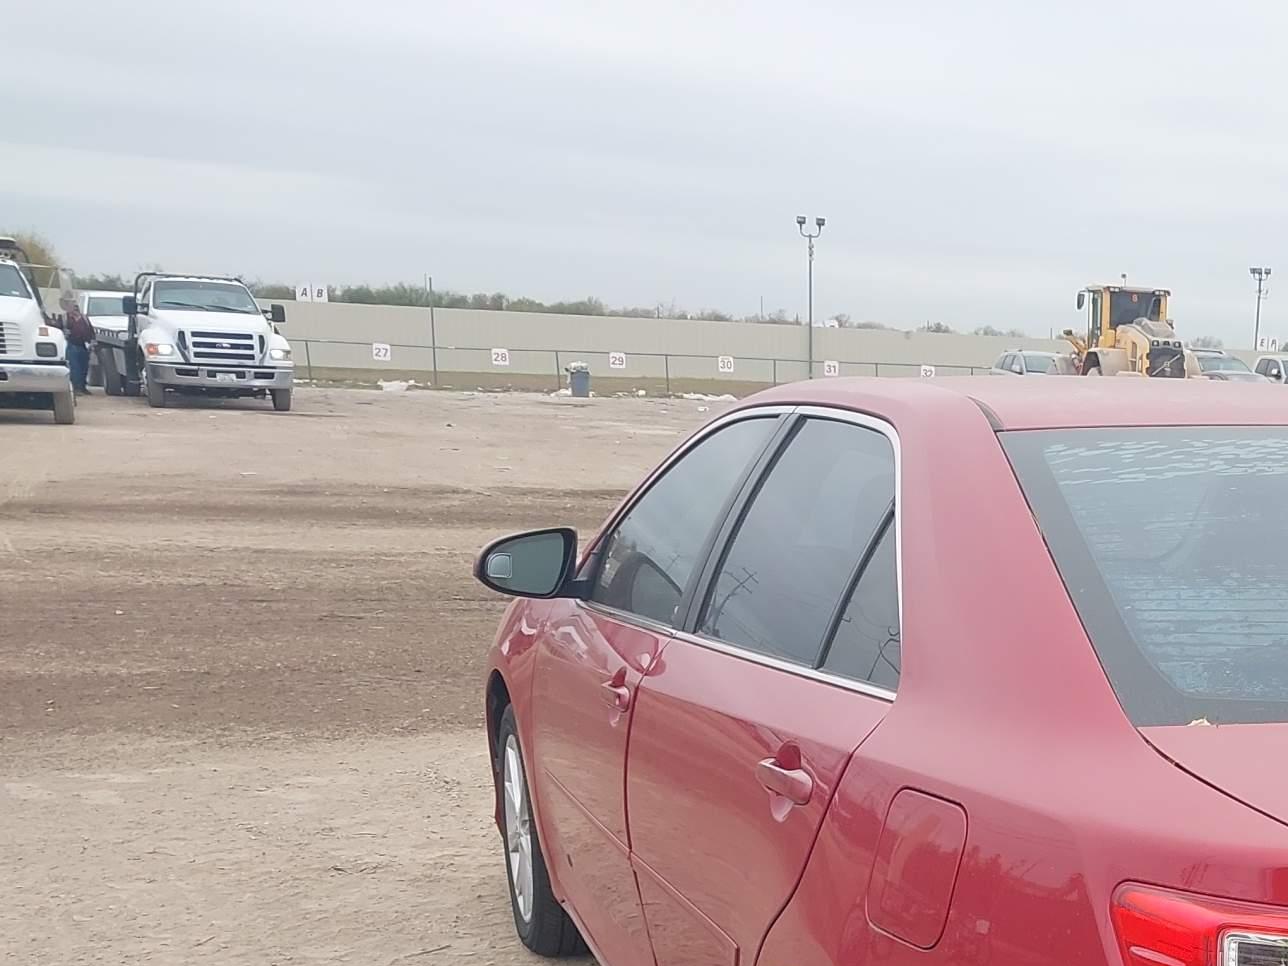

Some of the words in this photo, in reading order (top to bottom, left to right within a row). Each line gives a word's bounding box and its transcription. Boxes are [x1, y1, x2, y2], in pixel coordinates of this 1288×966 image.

[301, 287, 308, 297] A
[316, 288, 324, 298] B
[374, 347, 389, 358] 27
[493, 352, 507, 362] 28
[611, 356, 624, 366] 29
[719, 360, 732, 370] 30
[825, 364, 837, 374] 31
